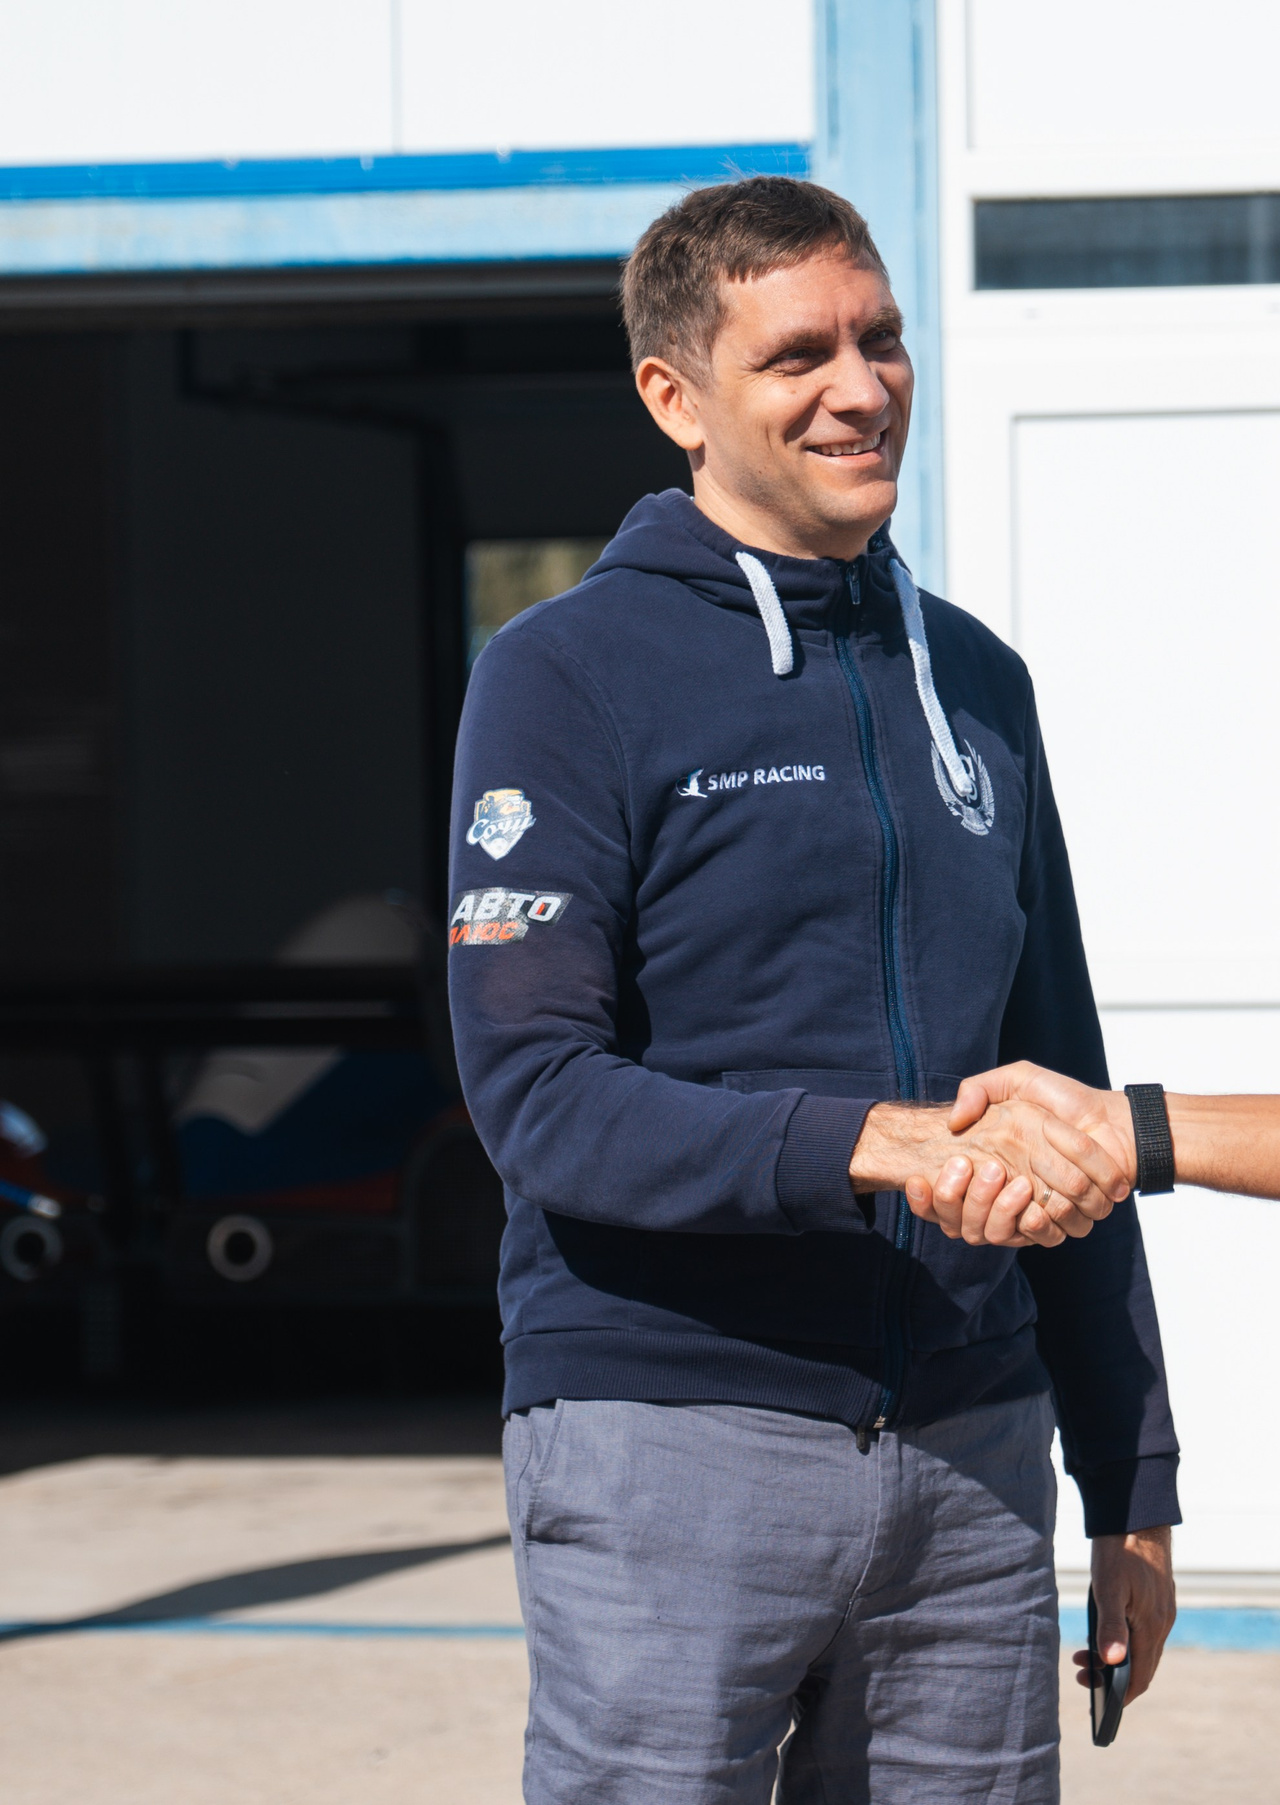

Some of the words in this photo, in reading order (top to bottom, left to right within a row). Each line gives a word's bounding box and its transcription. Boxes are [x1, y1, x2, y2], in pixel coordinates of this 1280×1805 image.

[707, 771, 748, 791] SMP
[753, 765, 826, 785] RACING
[451, 892, 561, 925] АВТО
